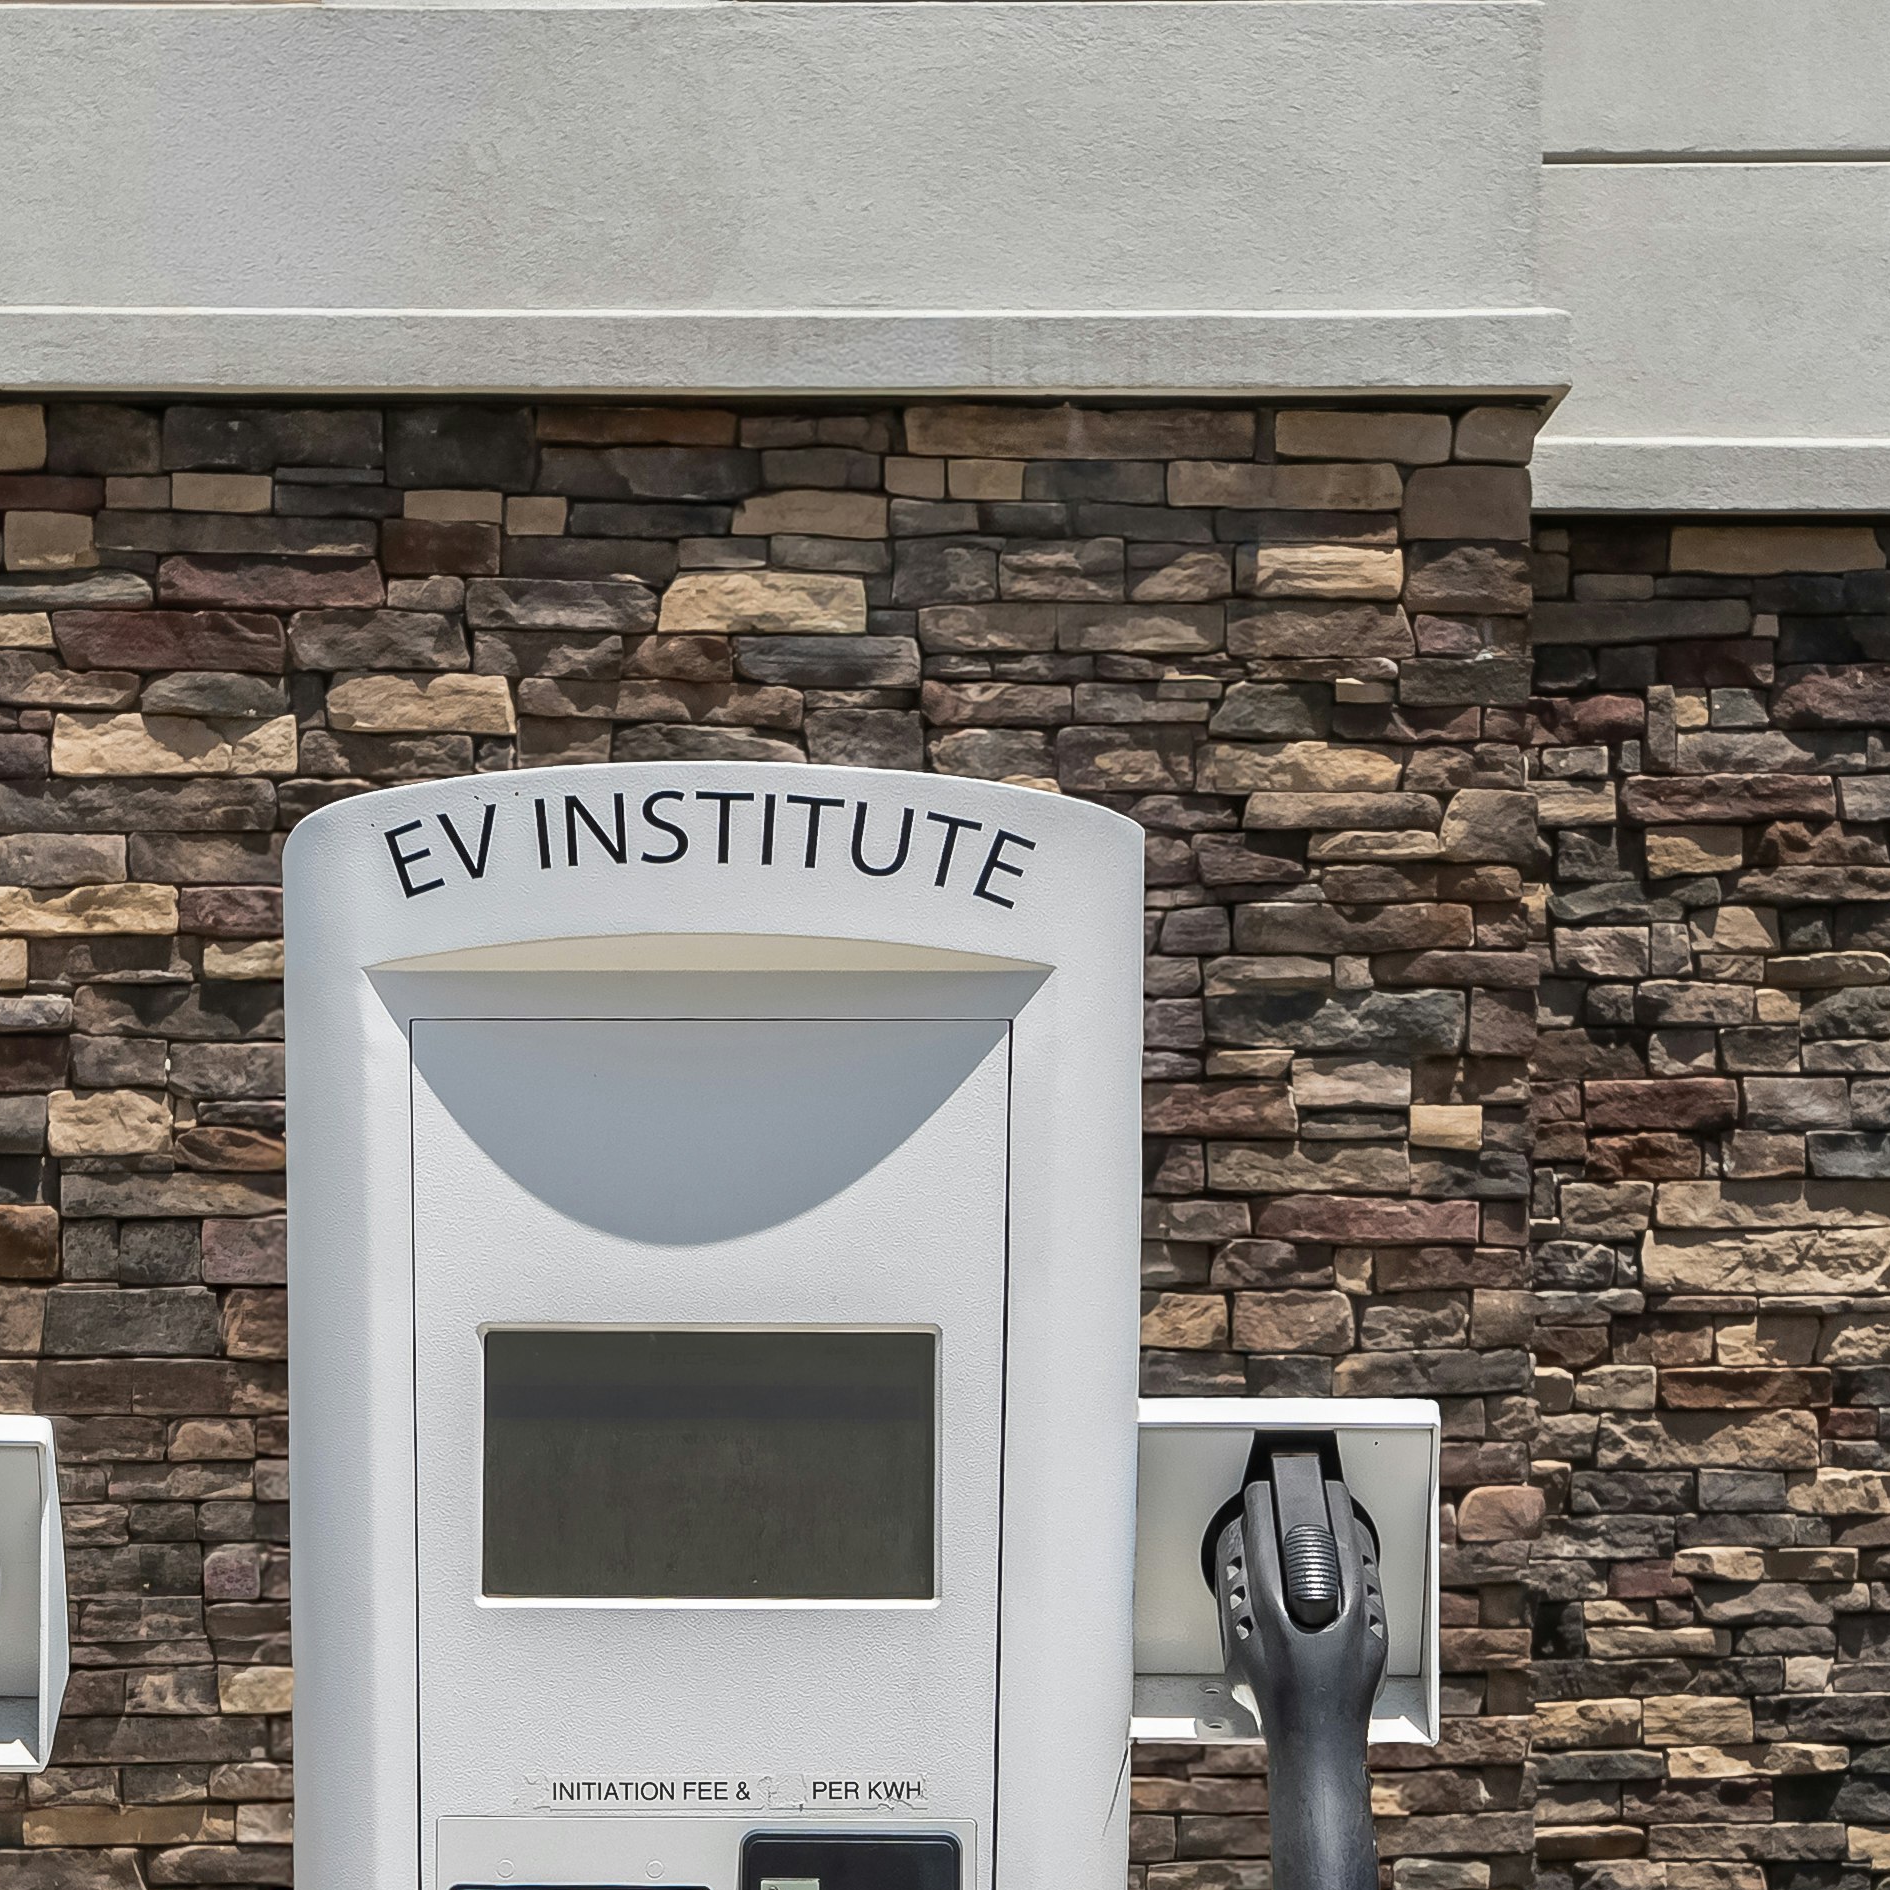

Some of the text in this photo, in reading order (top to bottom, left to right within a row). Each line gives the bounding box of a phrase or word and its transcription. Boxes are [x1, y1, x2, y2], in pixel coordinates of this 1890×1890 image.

[383, 790, 1037, 909] EV INSTITUTE
[552, 1781, 921, 1801] INITIATION FEE & PER KWH
